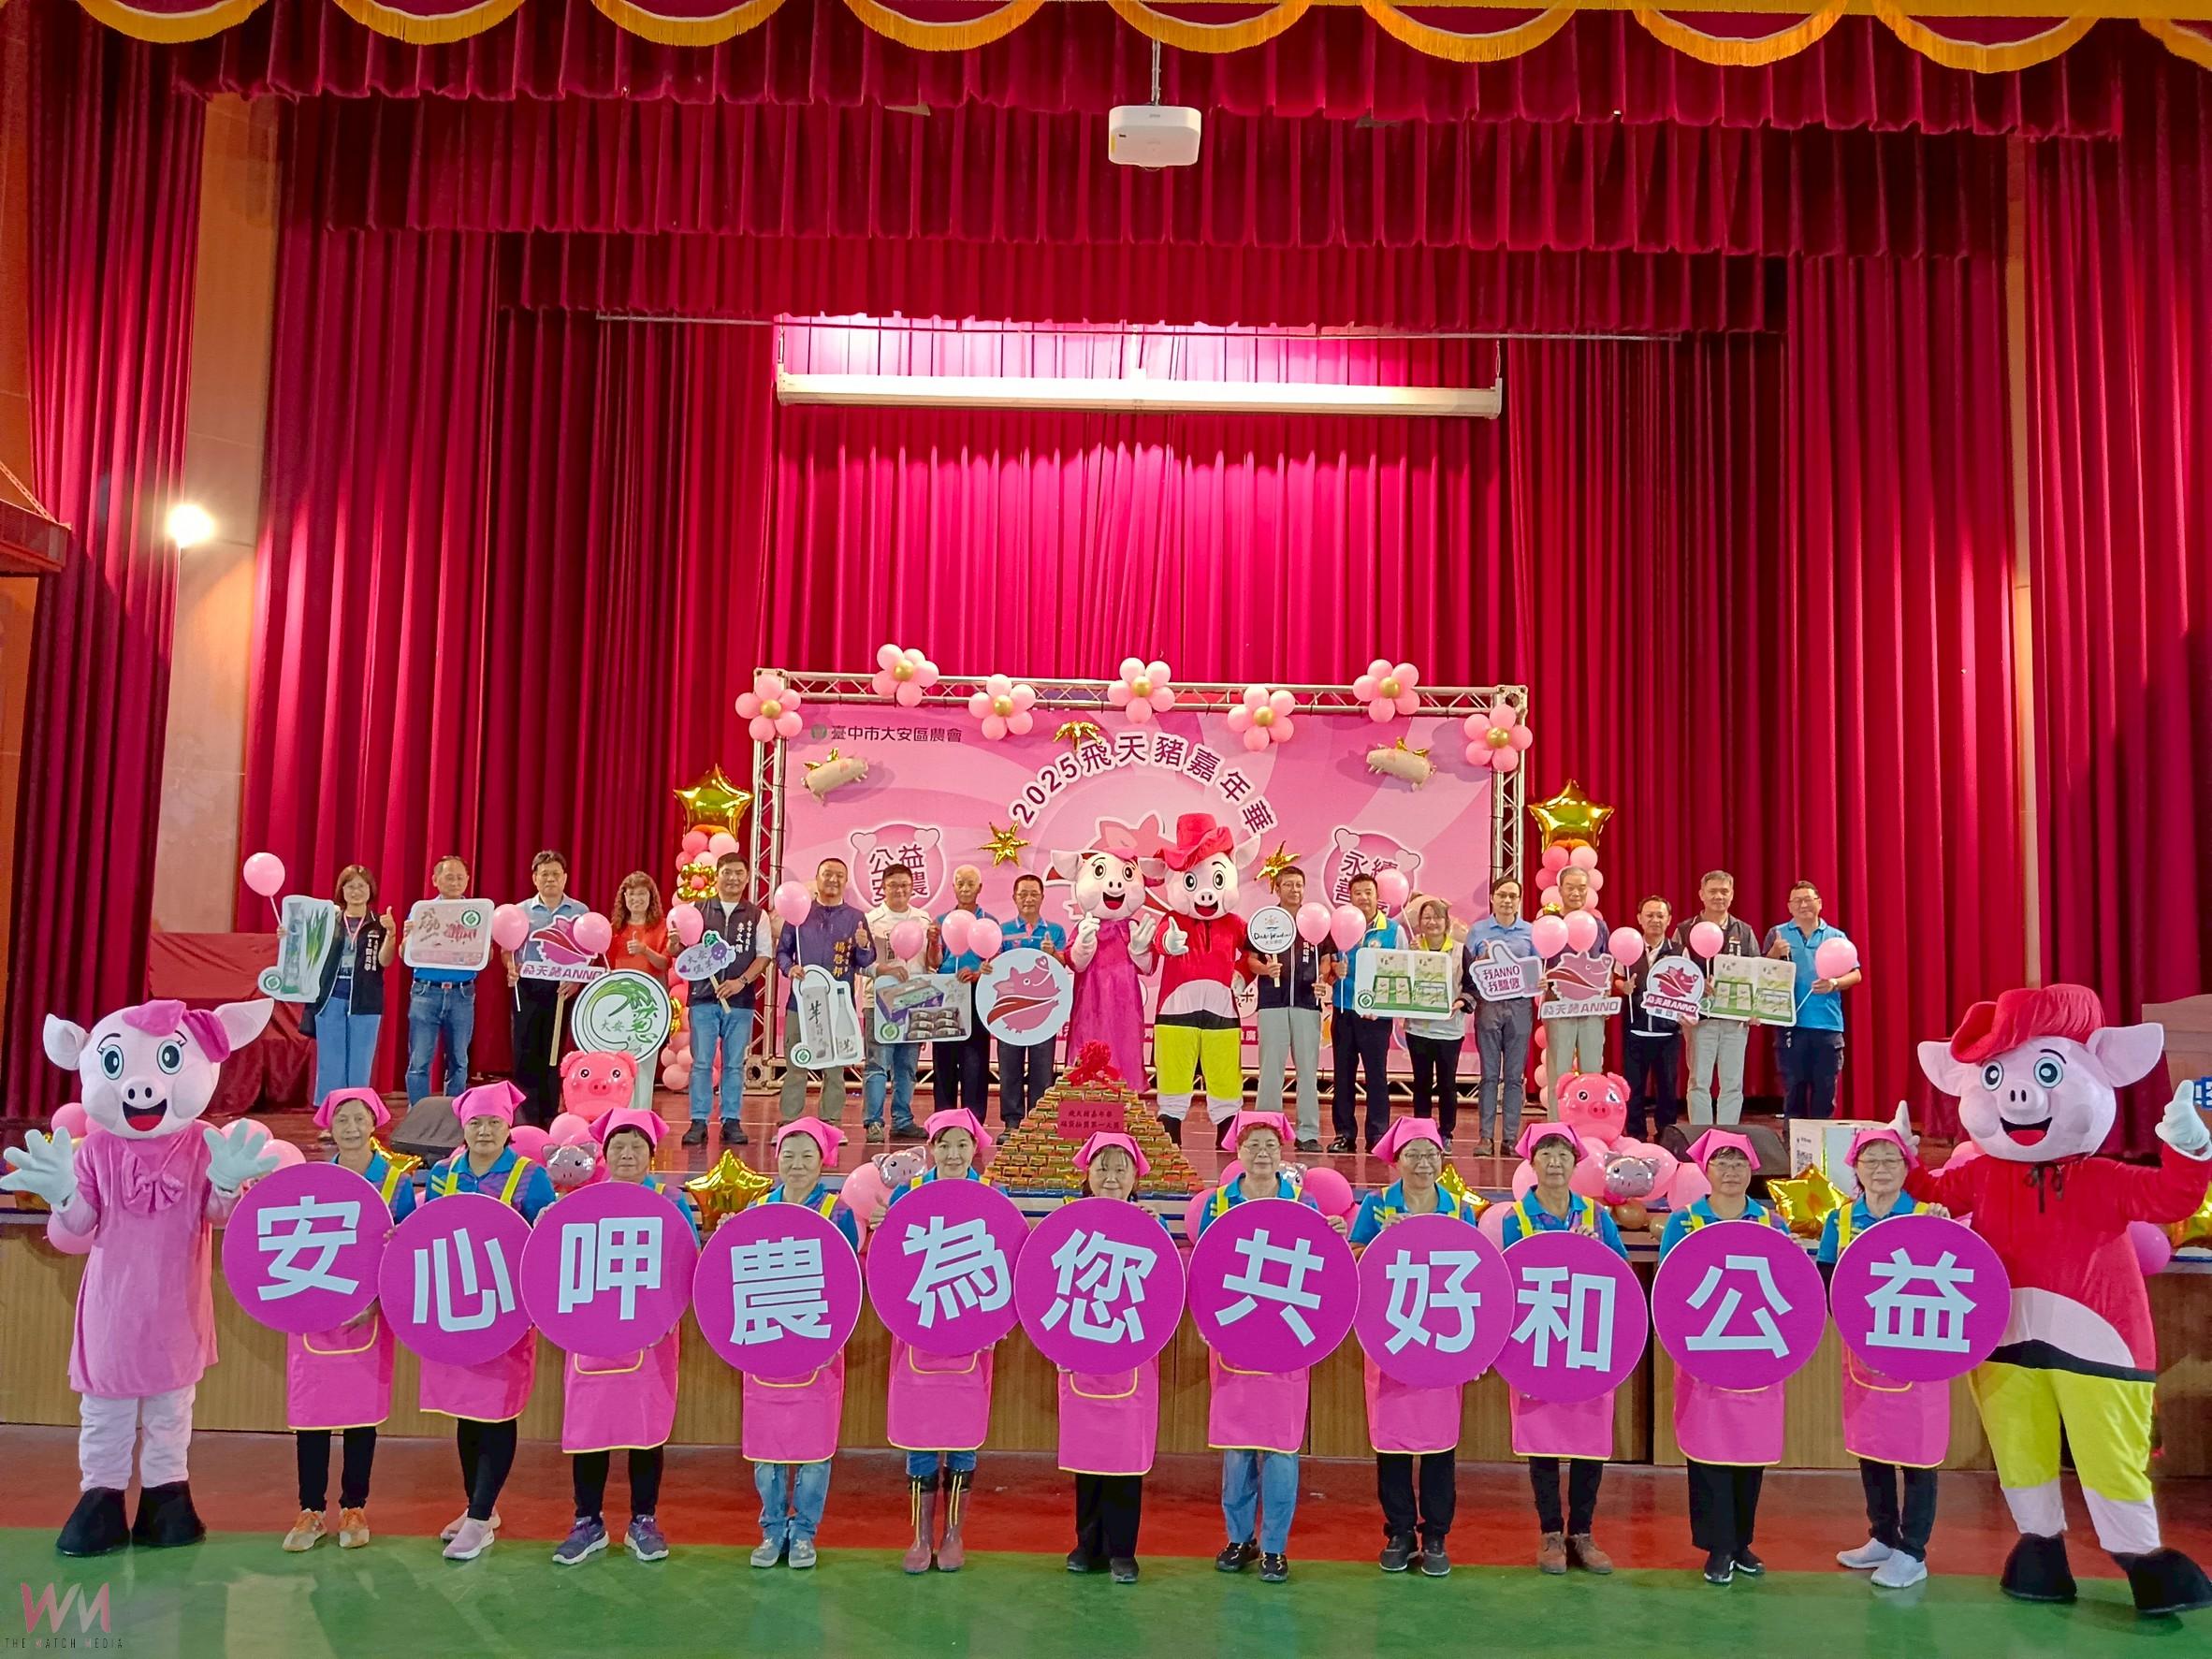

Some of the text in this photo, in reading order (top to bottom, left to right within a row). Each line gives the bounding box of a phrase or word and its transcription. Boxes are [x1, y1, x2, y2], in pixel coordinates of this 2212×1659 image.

[831, 724, 963, 743] 臺中市大安區農會
[1011, 735, 1274, 834] 2025飛天豬嘉年華
[257, 1196, 360, 1300] 安
[414, 1228, 515, 1332] 心
[559, 1217, 662, 1319] 呷
[730, 1237, 831, 1345] 農
[902, 1216, 1011, 1328] 為
[1041, 1230, 1157, 1343] 您
[1215, 1229, 1324, 1346] 共
[1865, 1248, 1976, 1352] 益
[1385, 1249, 1481, 1354] 好
[1511, 1267, 1615, 1372] 和
[1685, 1255, 1792, 1358] 公
